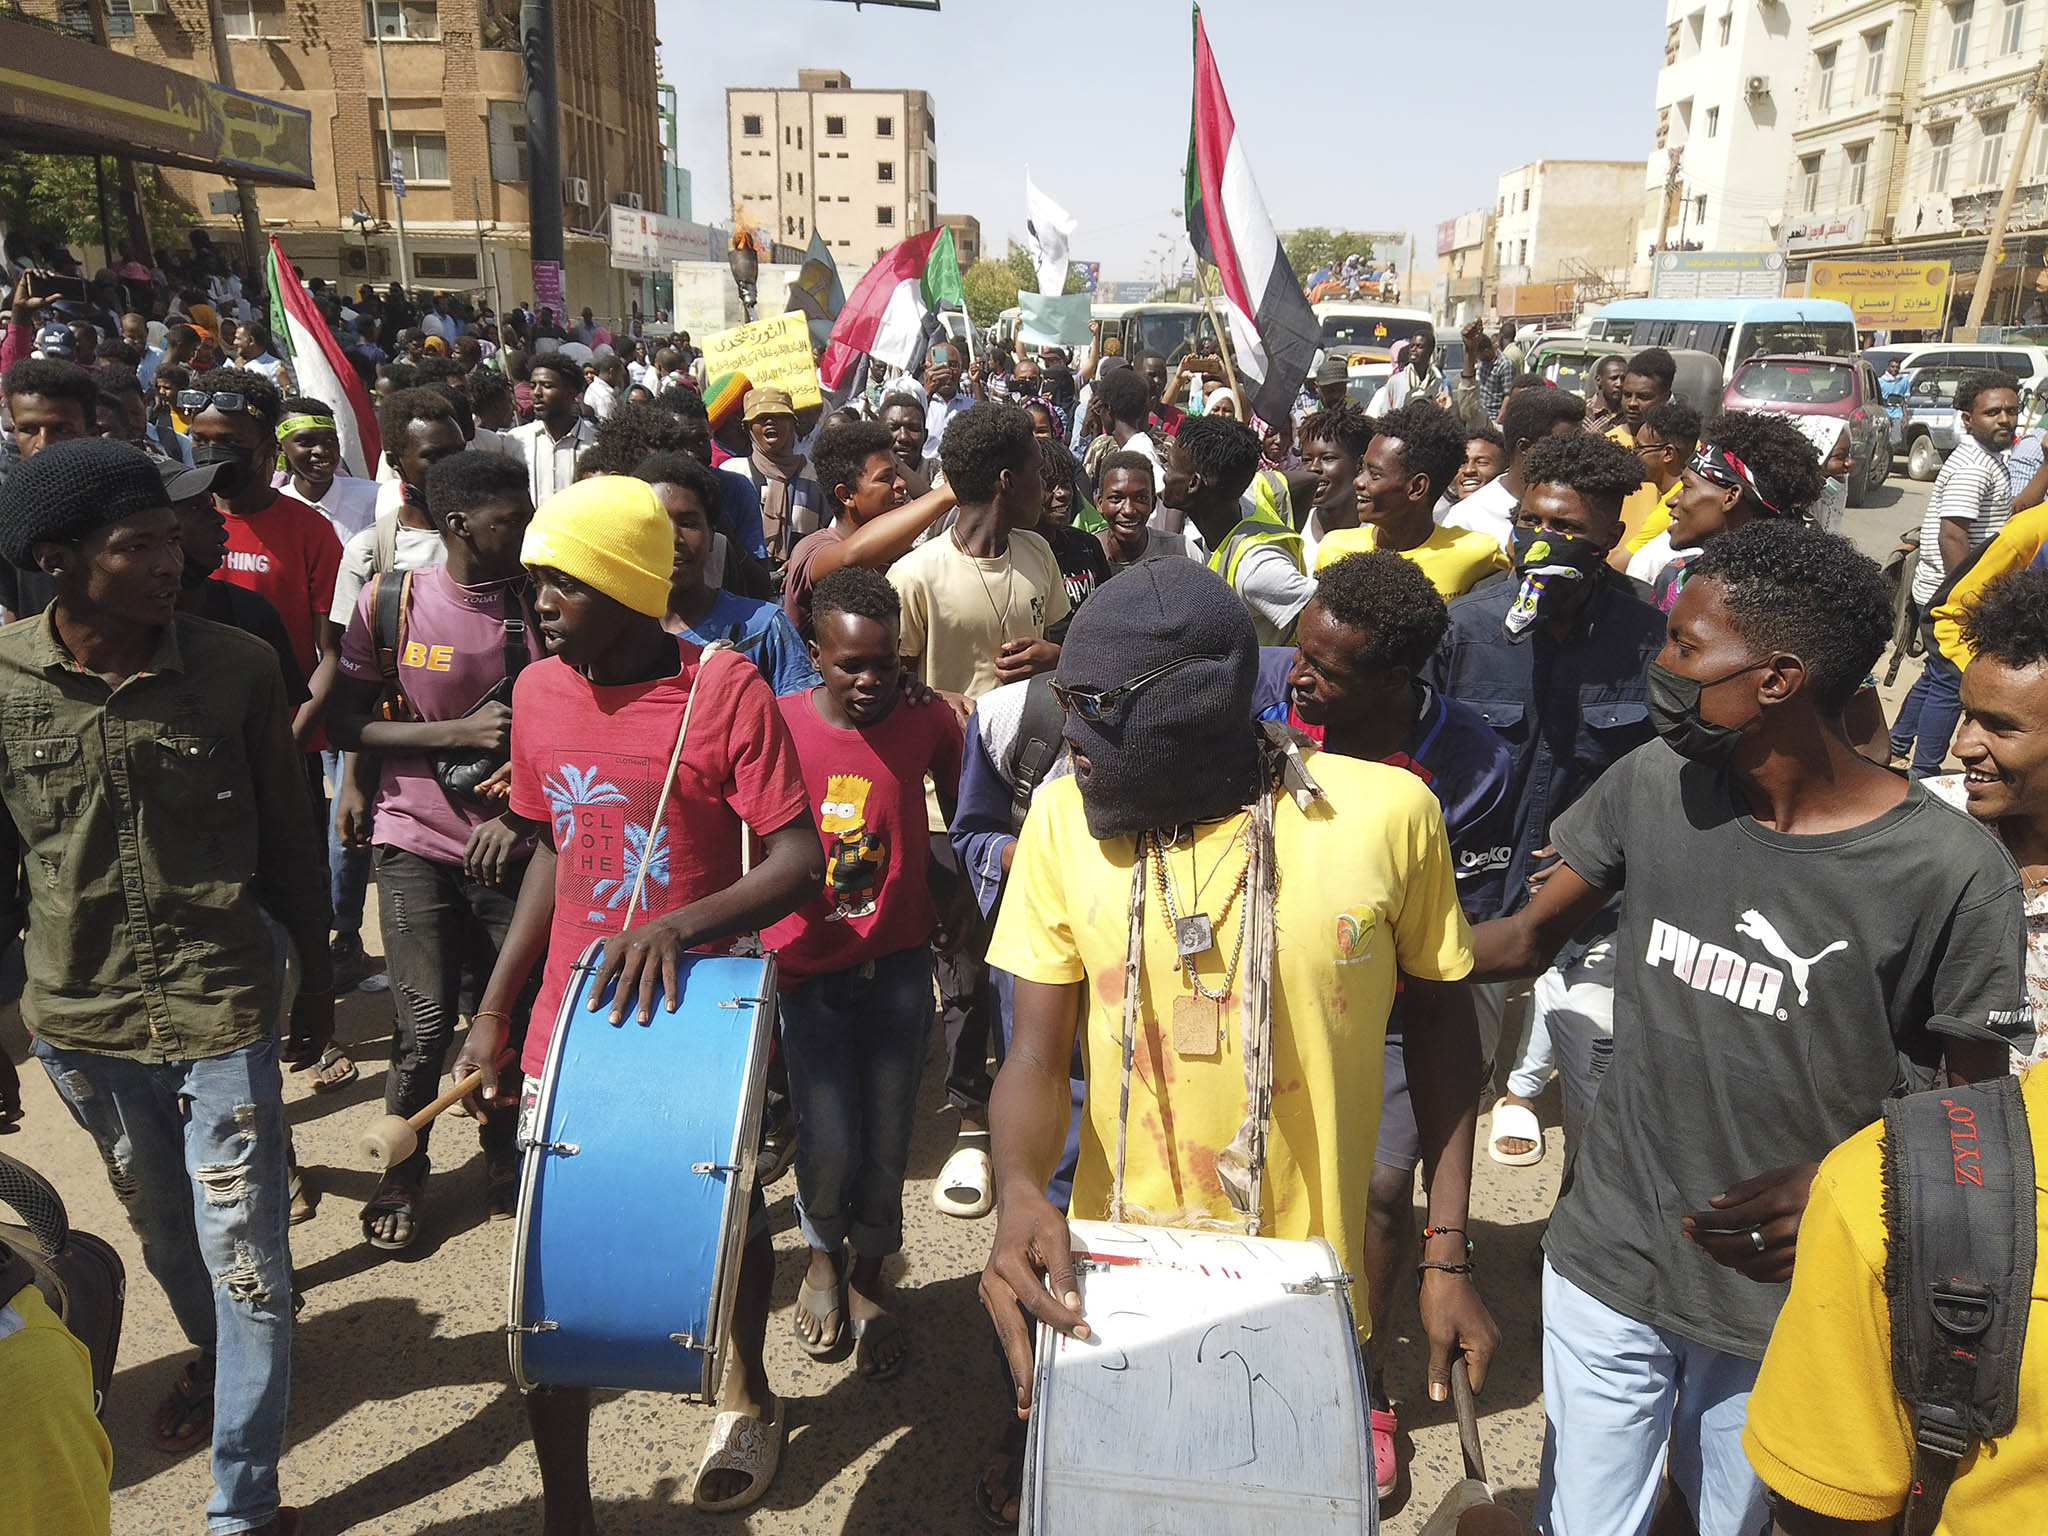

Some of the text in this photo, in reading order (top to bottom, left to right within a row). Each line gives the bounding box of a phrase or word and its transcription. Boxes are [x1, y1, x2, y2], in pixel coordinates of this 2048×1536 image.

[401, 640, 454, 672] BE
[1460, 846, 1512, 868] beko
[1645, 918, 1785, 1016] PUMA
